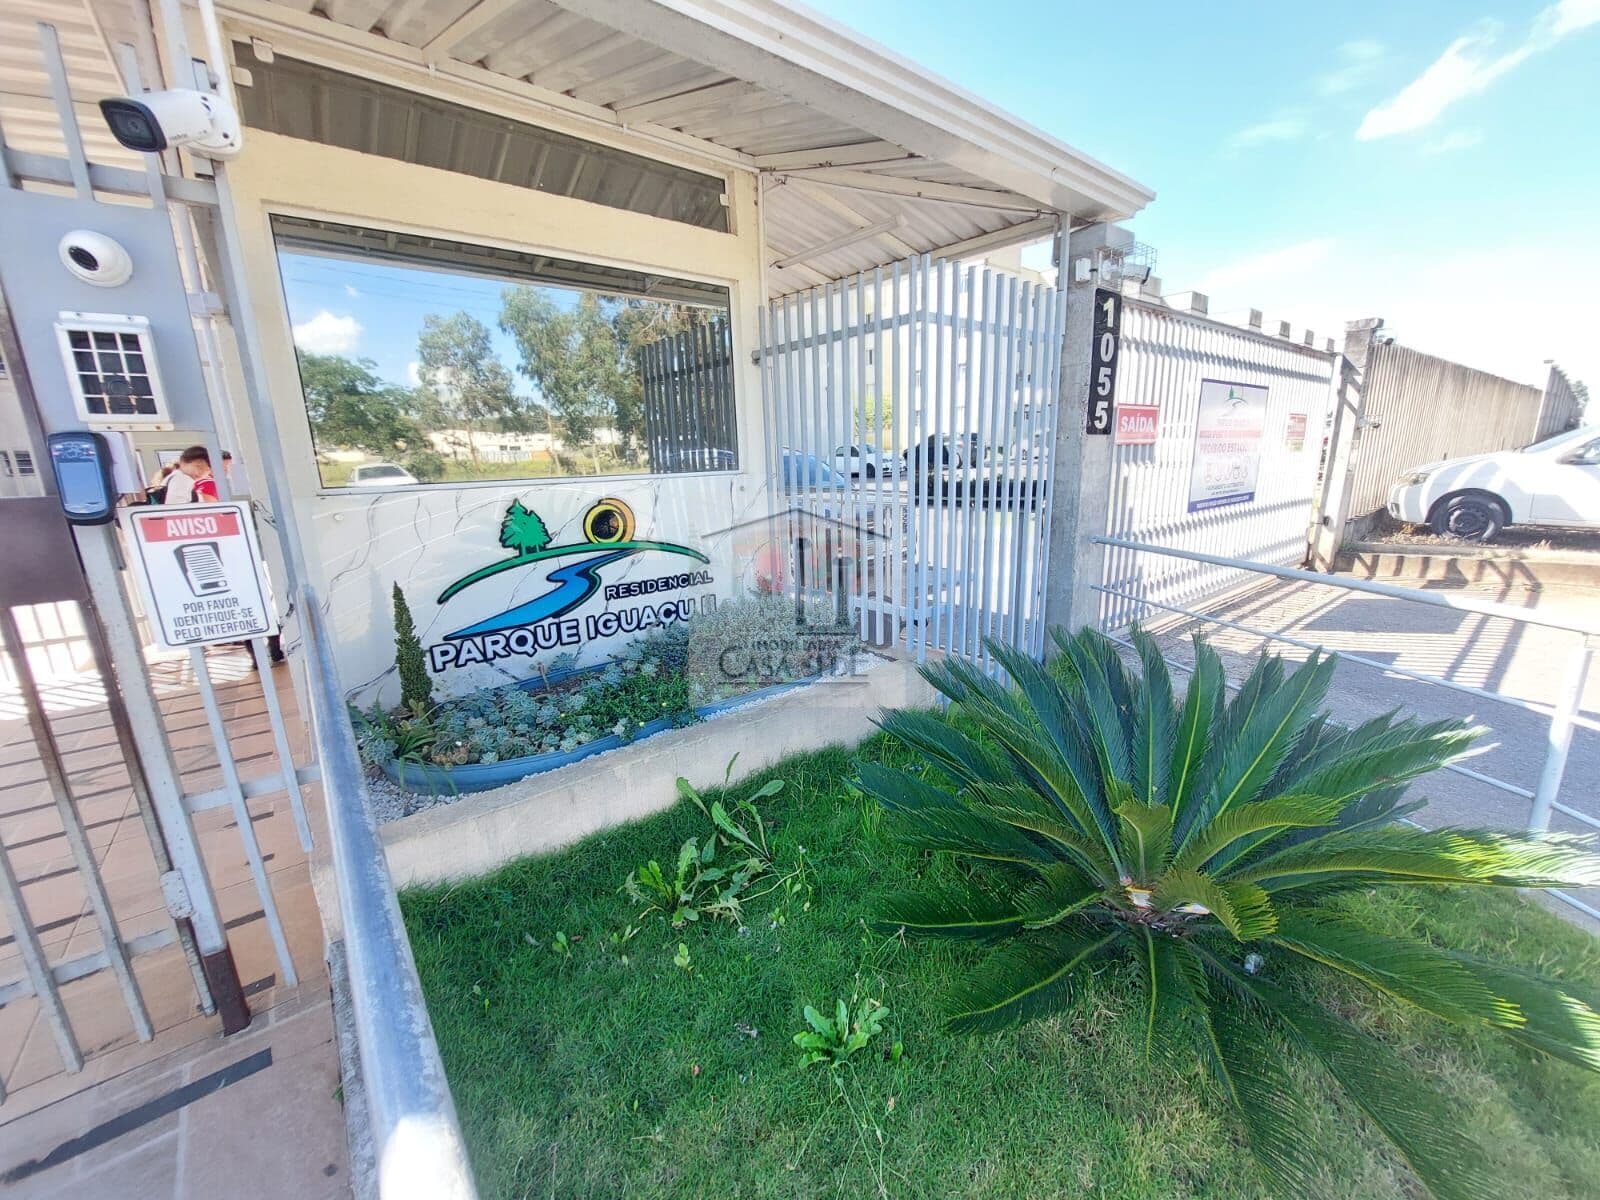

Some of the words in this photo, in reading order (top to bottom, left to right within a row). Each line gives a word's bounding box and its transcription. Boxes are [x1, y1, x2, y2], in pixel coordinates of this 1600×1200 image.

[1094, 297, 1115, 429] 1055
[1120, 412, 1156, 433] SAÍDA
[166, 516, 218, 538] AVISO
[605, 570, 713, 600] RESIDENCIAL
[183, 601, 204, 614] POR
[207, 597, 240, 612] FAVOR
[173, 607, 254, 628] IDENTIFIQUE-SE
[174, 627, 200, 641] PELO
[203, 618, 259, 637] INTERFONE
[430, 618, 581, 673] PARQUE
[586, 597, 696, 640] IGUAÇU
